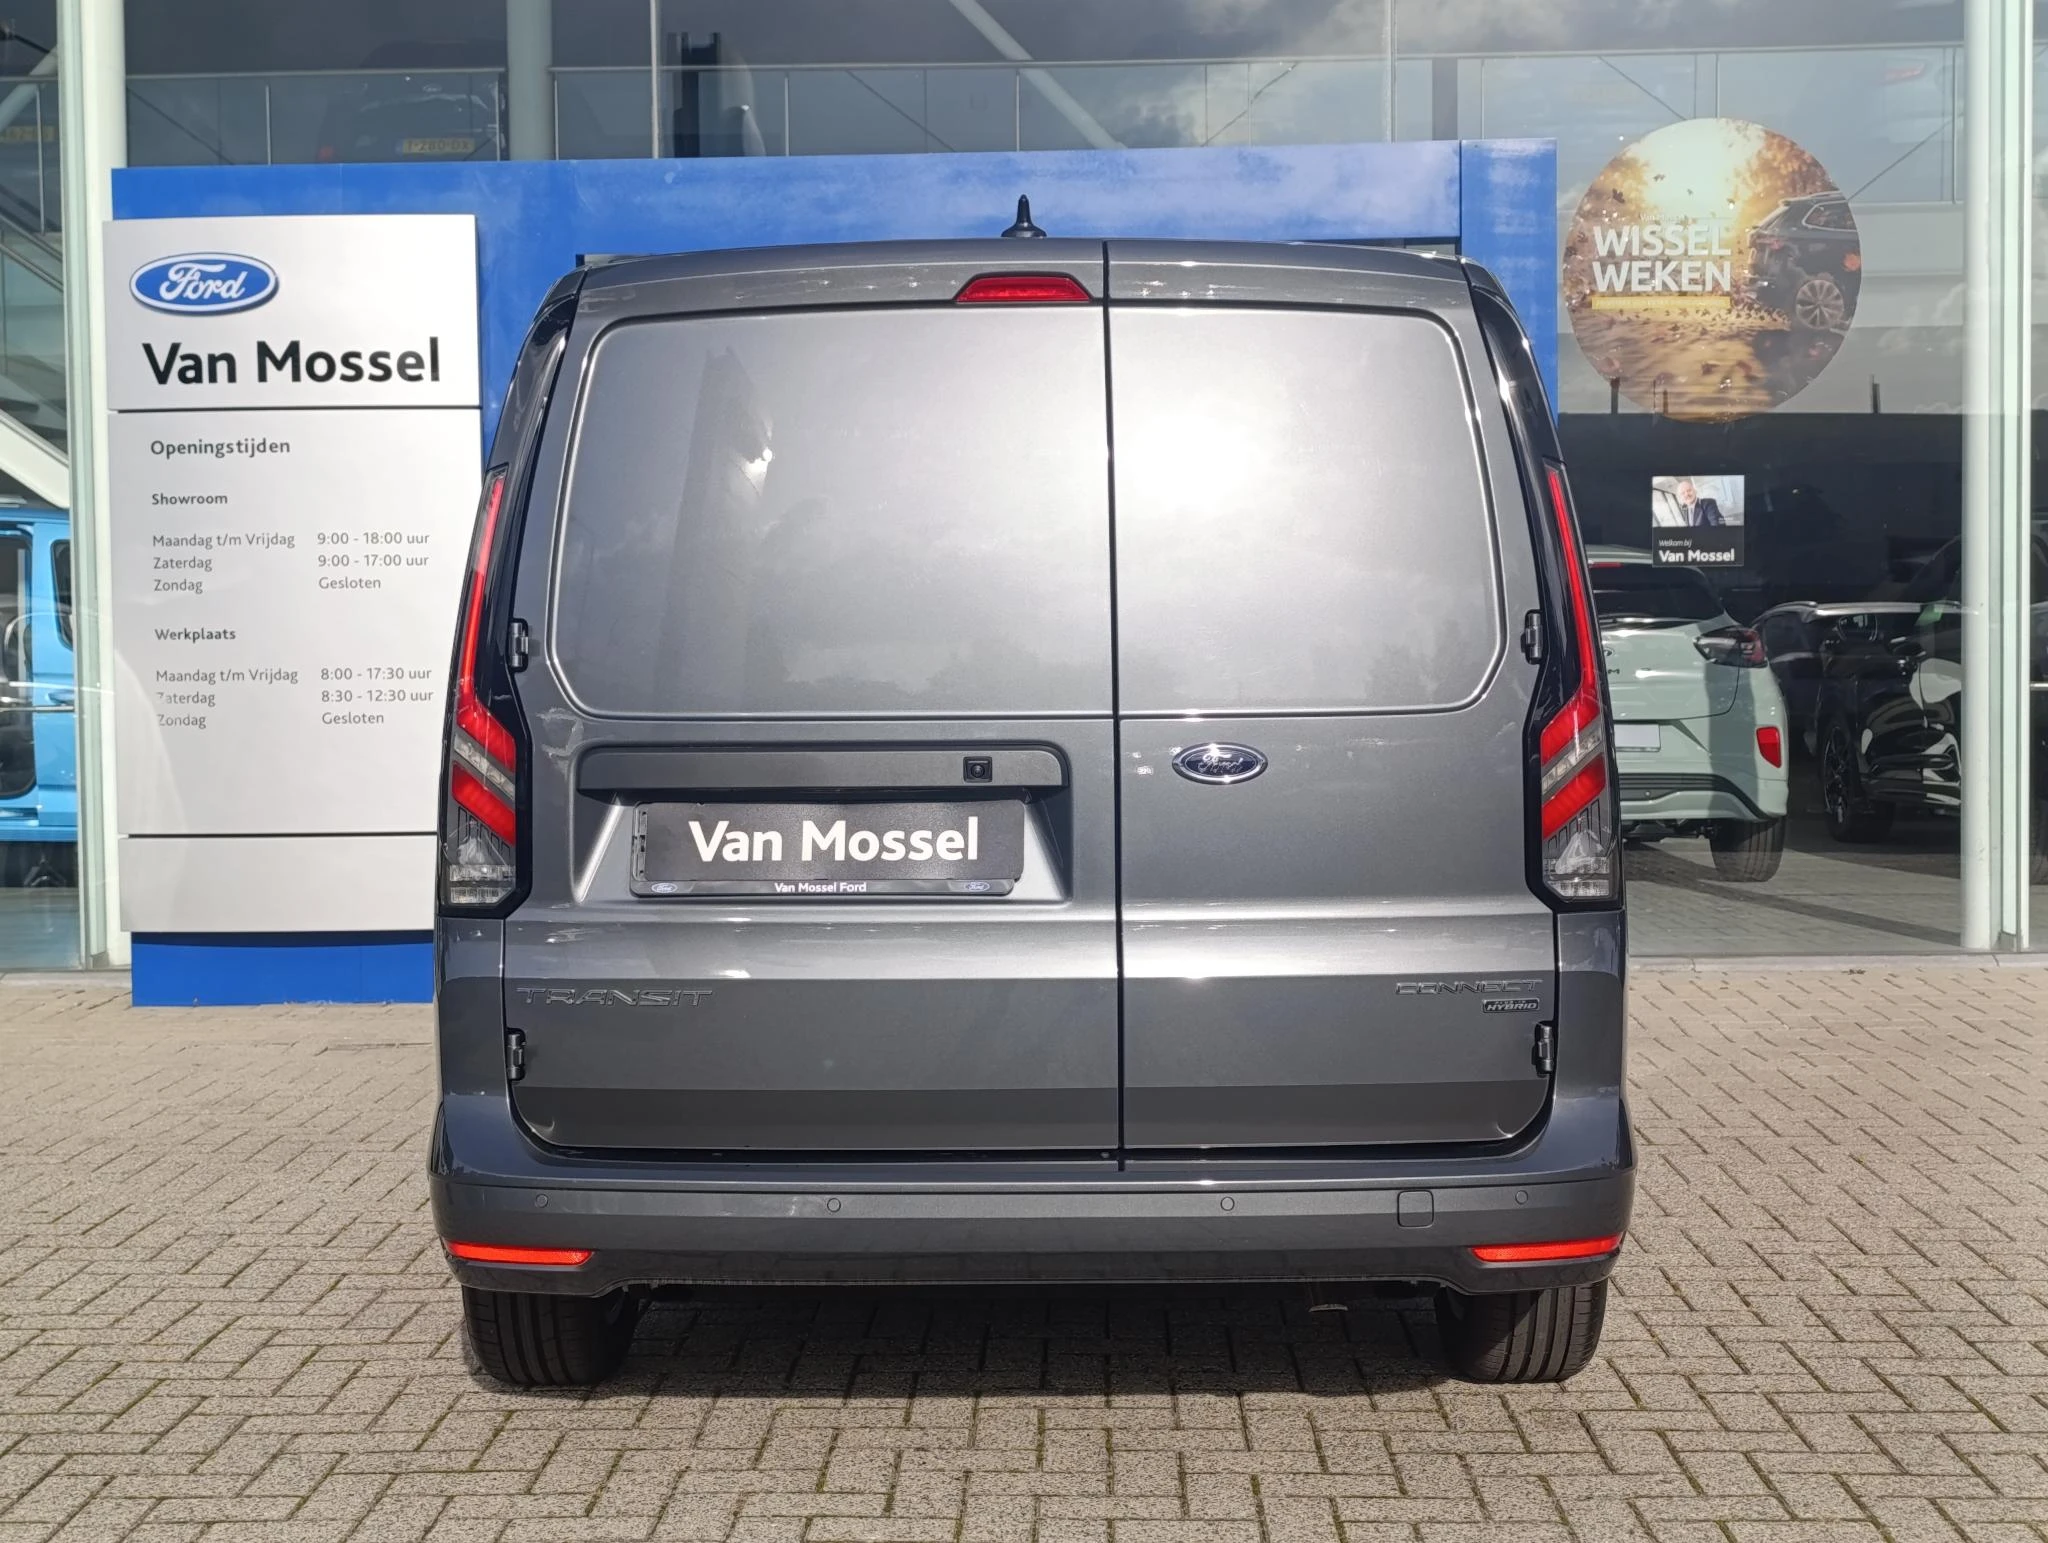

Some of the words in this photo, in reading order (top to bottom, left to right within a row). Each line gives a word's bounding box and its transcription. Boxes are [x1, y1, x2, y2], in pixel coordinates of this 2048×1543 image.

[1592, 224, 1732, 257] WISSEL
[159, 262, 249, 301] Ford
[1592, 260, 1731, 292] WEKEN
[141, 342, 237, 385] Van
[256, 336, 440, 383] Mossel
[150, 438, 290, 459] Openingstijden
[152, 493, 228, 506] Showroom
[152, 534, 213, 550] Maandag
[216, 534, 242, 547] t/m
[246, 533, 296, 549] Vrijdag
[317, 532, 350, 545] 9:00
[363, 532, 403, 545] 18:00
[406, 534, 430, 545] uur
[153, 556, 213, 572] Zaterdag
[317, 554, 350, 567] 9:00
[364, 553, 402, 567] 17:00
[406, 556, 430, 567] uur
[1659, 549, 1685, 562] Van
[1688, 548, 1735, 562] Mossel
[153, 578, 203, 594] Zondag
[318, 576, 382, 590] Gesloten
[154, 628, 237, 643] Werkplaats
[156, 668, 216, 686] Maandag
[219, 667, 245, 682] t/m
[248, 667, 299, 684] Vrijdag
[320, 668, 353, 681] 8:00
[366, 667, 405, 681] 17:30
[408, 668, 432, 681] uur
[321, 690, 353, 703] 8:30
[366, 689, 406, 703] 12:30
[409, 690, 434, 703] uur
[157, 713, 207, 730] Zondag
[322, 712, 385, 726] Gesloten
[688, 820, 783, 862] Van
[801, 816, 979, 862] Mossel
[774, 882, 796, 893] Van
[799, 881, 837, 893] Mossel
[839, 881, 867, 892] Ford
[1396, 979, 1543, 996] CONNECT
[516, 987, 713, 1007] TRANSIT
[1487, 1003, 1537, 1011] HYBRID
